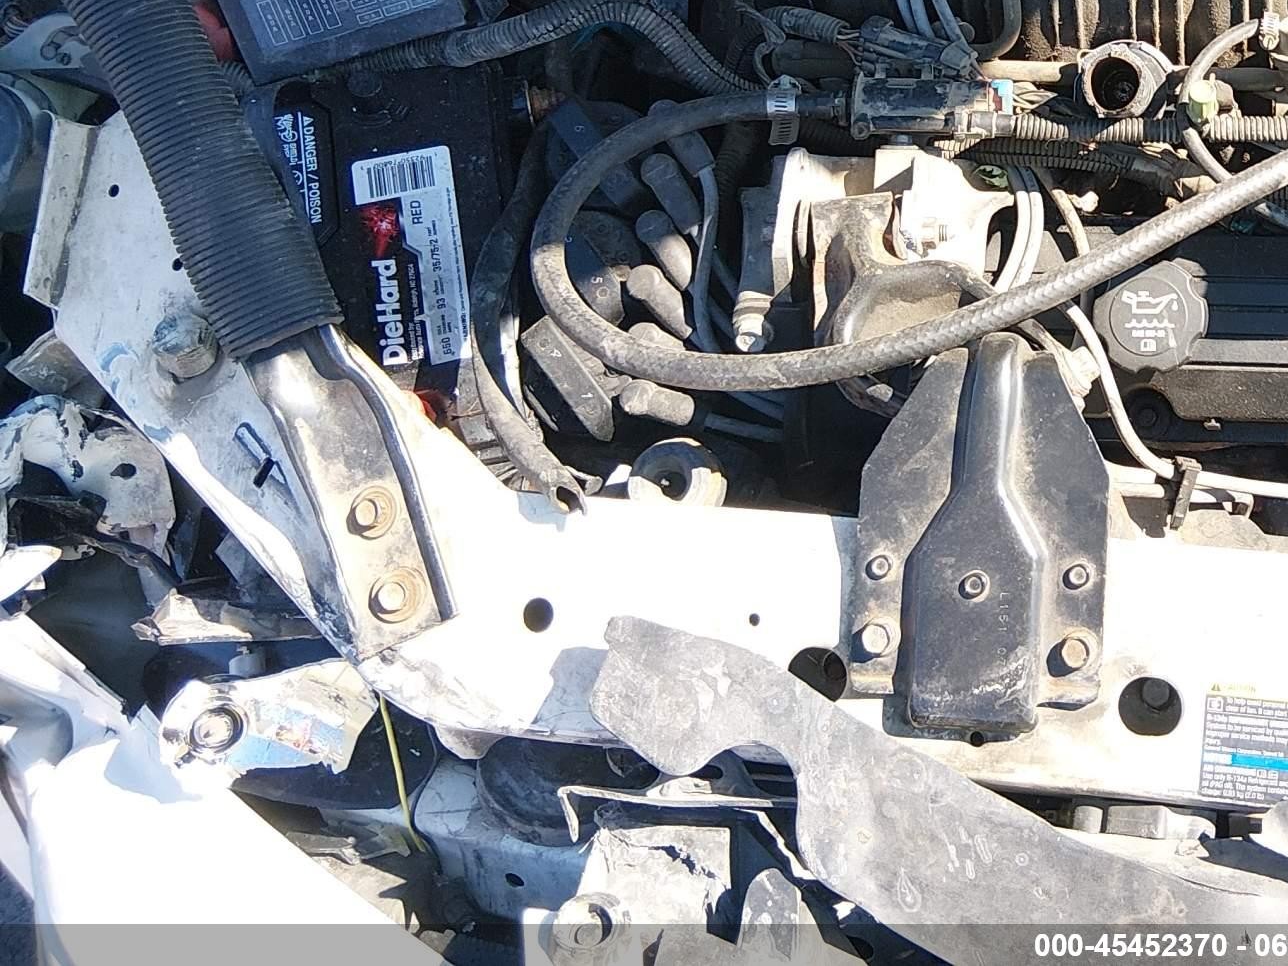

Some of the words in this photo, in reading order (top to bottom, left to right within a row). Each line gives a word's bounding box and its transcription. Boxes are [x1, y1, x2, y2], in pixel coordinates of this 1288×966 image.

[303, 126, 318, 172] DANGER
[308, 182, 322, 223] POISON
[410, 200, 423, 225] RED
[591, 276, 603, 284] 5
[371, 259, 408, 366] DieHard
[436, 297, 446, 310] 93
[441, 337, 452, 355] 650
